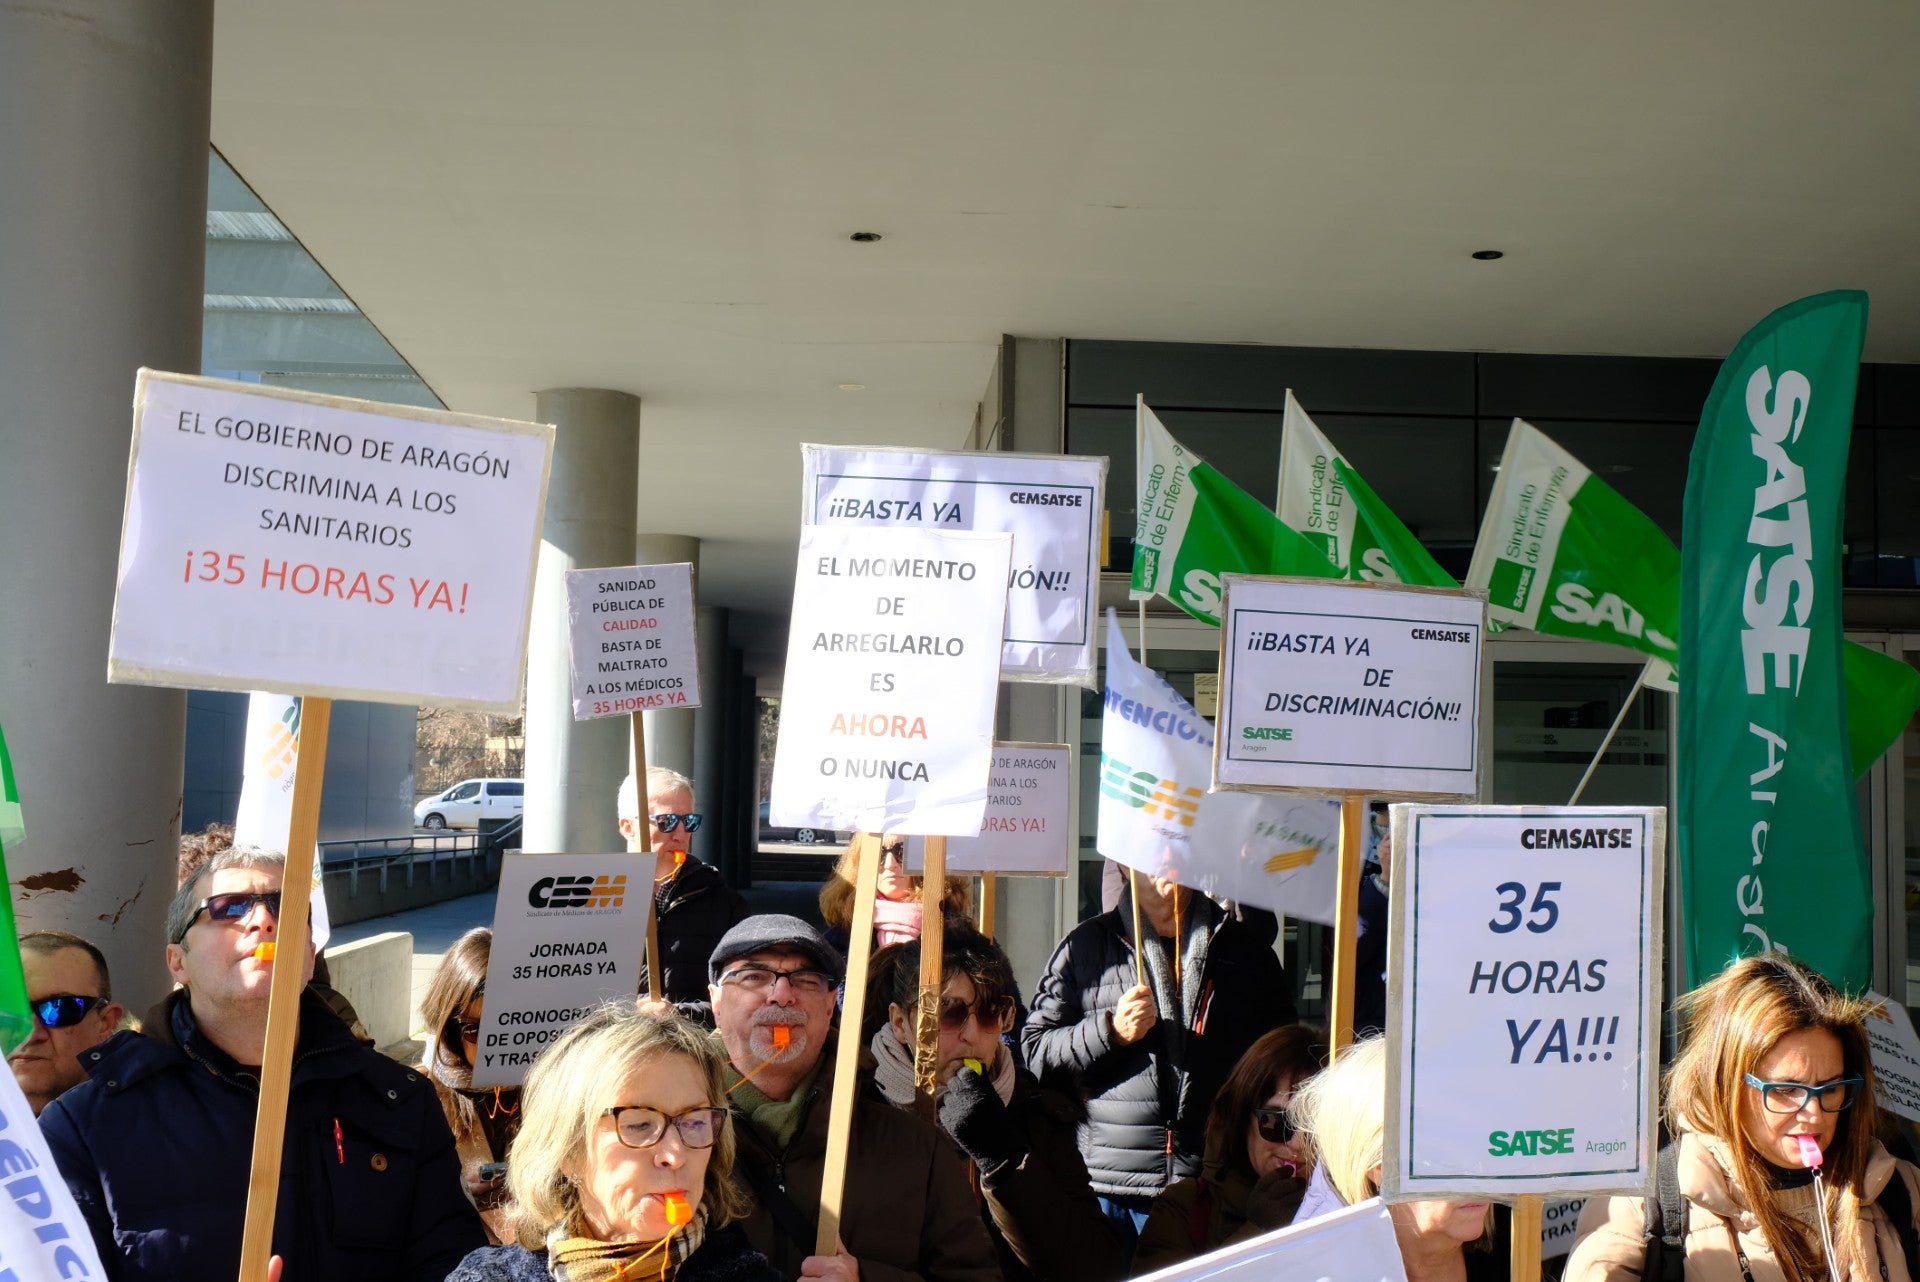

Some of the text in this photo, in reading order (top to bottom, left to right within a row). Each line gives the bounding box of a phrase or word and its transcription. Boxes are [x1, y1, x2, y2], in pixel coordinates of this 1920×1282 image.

[177, 410, 511, 480] EL GOBIERNO DE ARAGÓN
[223, 462, 457, 515] DISCRIMINA A LOS
[1009, 490, 1083, 508] CEMSATSE
[1308, 454, 1327, 529] Sindicato
[932, 501, 962, 523] YA
[1136, 463, 1166, 540] Sindicato
[258, 508, 413, 550] SANITARIOS
[1326, 510, 1339, 532] de
[1506, 484, 1537, 559] Sindicato
[1741, 364, 1814, 698] SATSE
[1150, 524, 1167, 546] de
[1525, 543, 1540, 564] de
[817, 556, 977, 582] EL MOMENTO
[1143, 549, 1156, 590] SATSE
[183, 550, 470, 615] ¡35 HORAS YA!
[598, 579, 656, 593] SANIDAD
[1513, 568, 1533, 609] SATSE
[592, 597, 665, 613] PÚBLICA DE
[875, 597, 905, 616] DE
[603, 618, 657, 632] CALIDAD
[1410, 628, 1471, 643] CEMSATSE
[601, 638, 662, 653] BASTA DE
[812, 632, 965, 657] ARREGLARLO
[1343, 635, 1371, 657] YA
[598, 657, 668, 673] MALTRATO
[586, 677, 683, 695] A LOS MÉDICOS
[869, 672, 895, 693] ES
[1363, 668, 1394, 688] DE
[593, 691, 686, 714] 35 HORAS YA
[1264, 691, 1462, 722] DISCRIMINACIÓN!!
[829, 713, 929, 740] AHORA
[1242, 726, 1293, 741] SATSE
[1241, 743, 1268, 752] Aragón
[820, 756, 929, 783] O NUNCA
[999, 758, 1011, 768] DE
[1013, 757, 1056, 770] ARAGÓN
[1010, 778, 1017, 788] A
[1019, 778, 1038, 789] LOS
[987, 795, 1022, 806] TARIOS
[1021, 817, 1045, 832] YA!
[1520, 828, 1633, 850] CEMSATSE
[528, 875, 627, 909] CESM
[526, 910, 553, 918] Sindicato
[1488, 881, 1562, 934] 35
[529, 941, 608, 958] JORNADA
[512, 961, 617, 979] 35 HORAS YA
[1469, 959, 1607, 994] HORAS
[486, 1033, 509, 1047] DE
[1506, 1016, 1620, 1064] YA!!!
[484, 1054, 494, 1067] Y
[1488, 1128, 1627, 1157] SATSE Aragón
